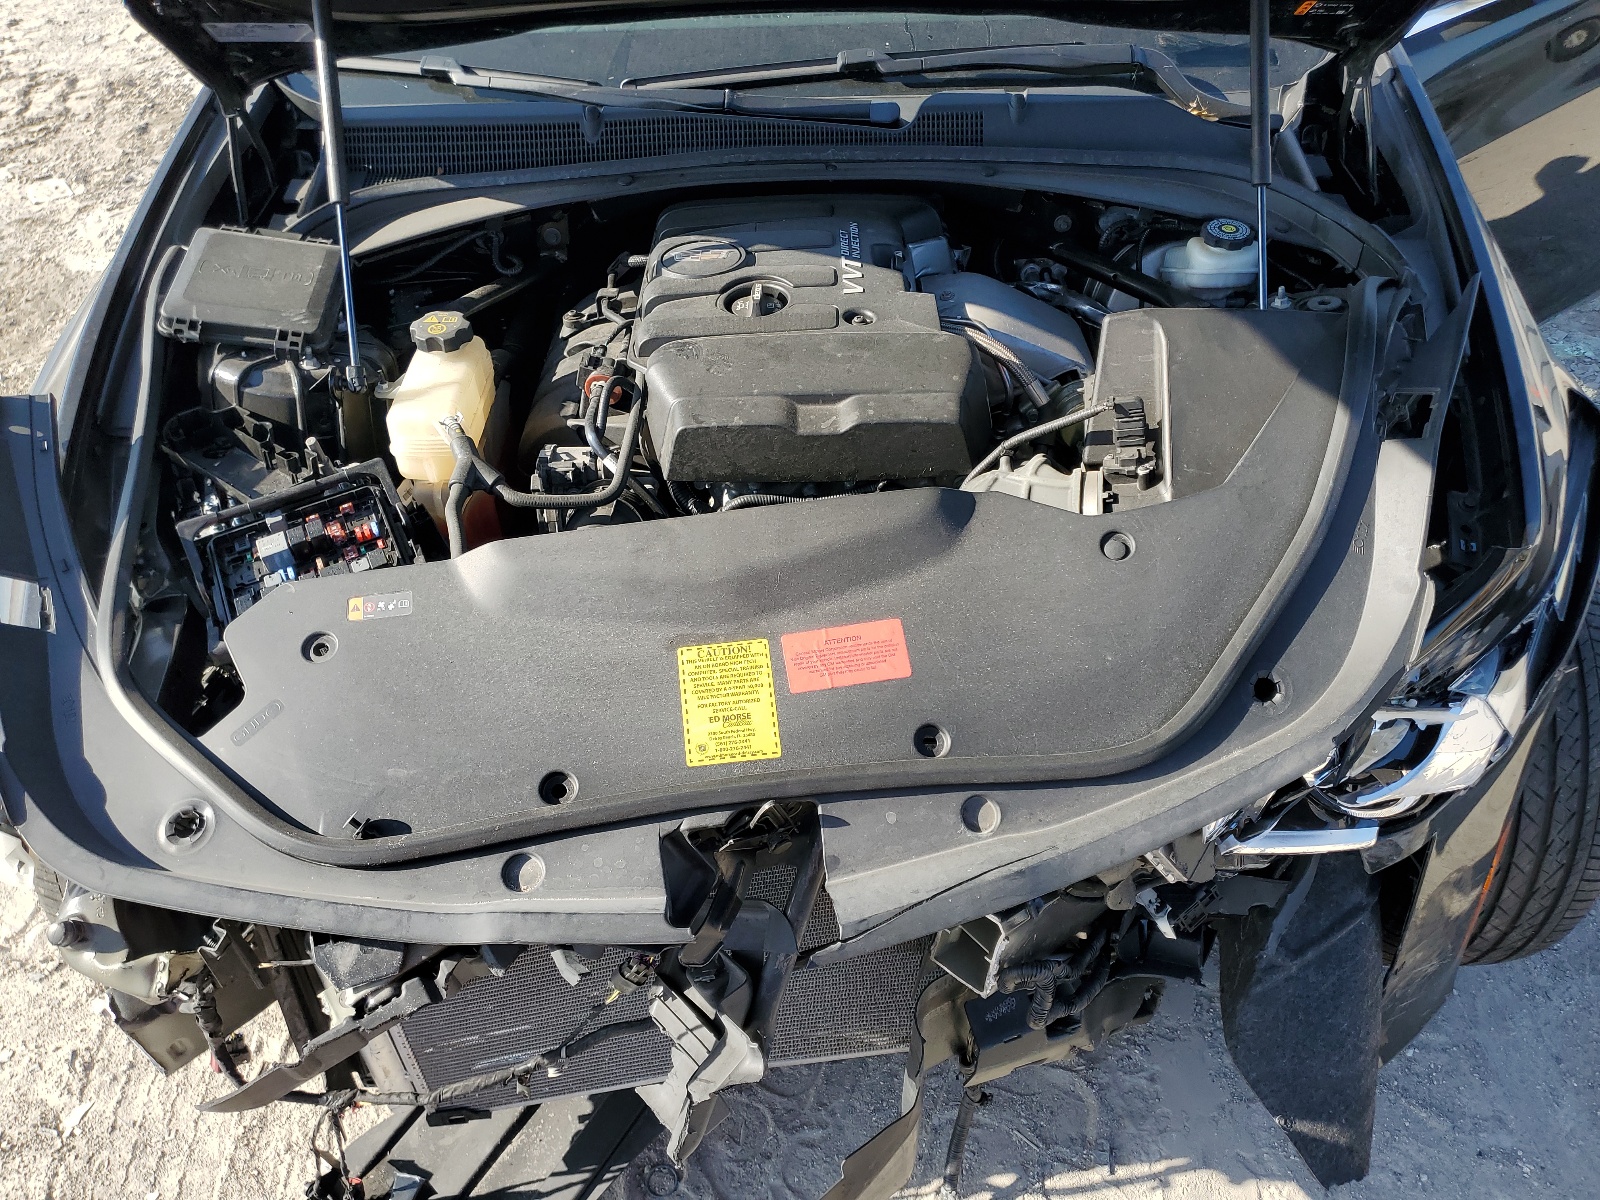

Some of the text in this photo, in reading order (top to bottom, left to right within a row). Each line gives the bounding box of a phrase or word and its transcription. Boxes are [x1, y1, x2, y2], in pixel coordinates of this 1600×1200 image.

[839, 229, 850, 256] DIRECT
[849, 221, 861, 259] INJECTION
[841, 256, 865, 295] VVT
[825, 635, 862, 646] ATTENTION
[697, 646, 751, 658] CAUTION!
[708, 713, 751, 724] ED MORSE
